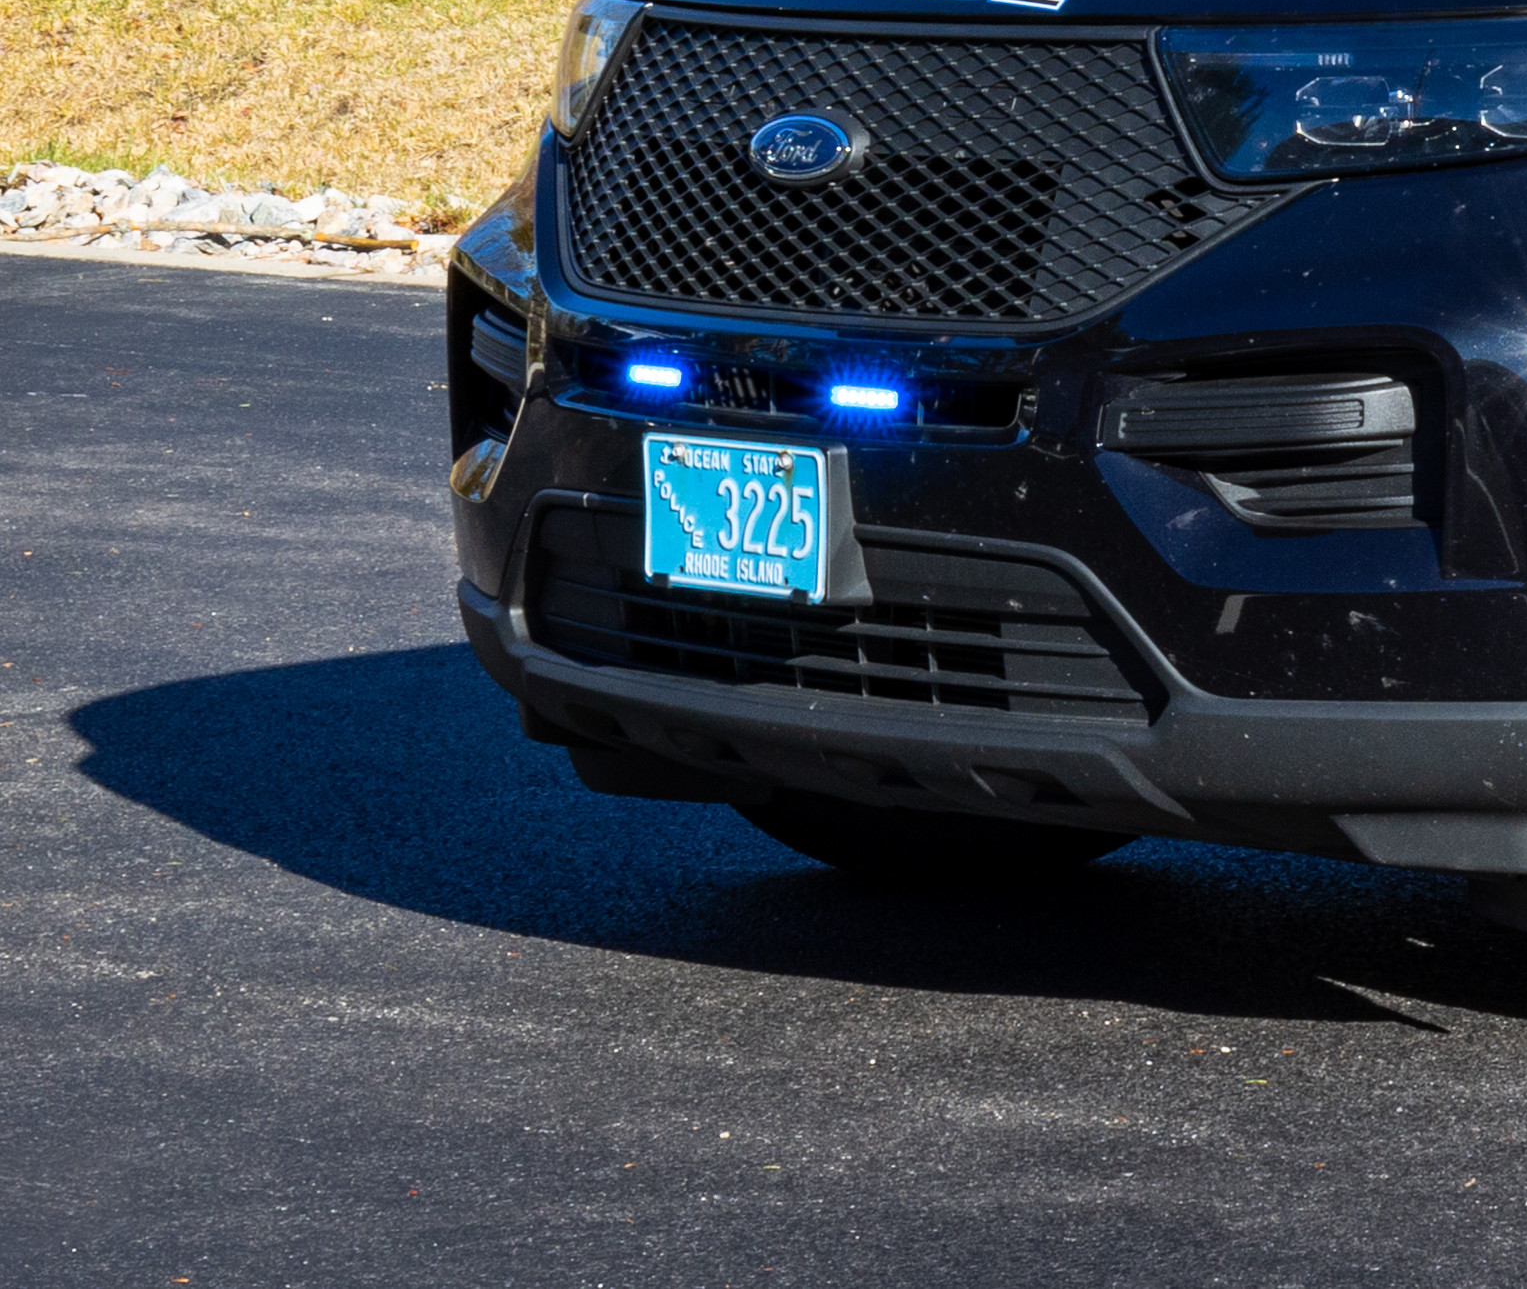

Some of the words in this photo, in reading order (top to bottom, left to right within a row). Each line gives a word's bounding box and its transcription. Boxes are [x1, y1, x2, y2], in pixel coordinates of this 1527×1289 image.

[766, 127, 823, 164] Ford
[685, 446, 731, 471] OCEAN
[653, 469, 704, 548] POLICE
[717, 477, 815, 559] 3225
[685, 552, 730, 579] RHODE
[736, 558, 784, 586] ISLAND
